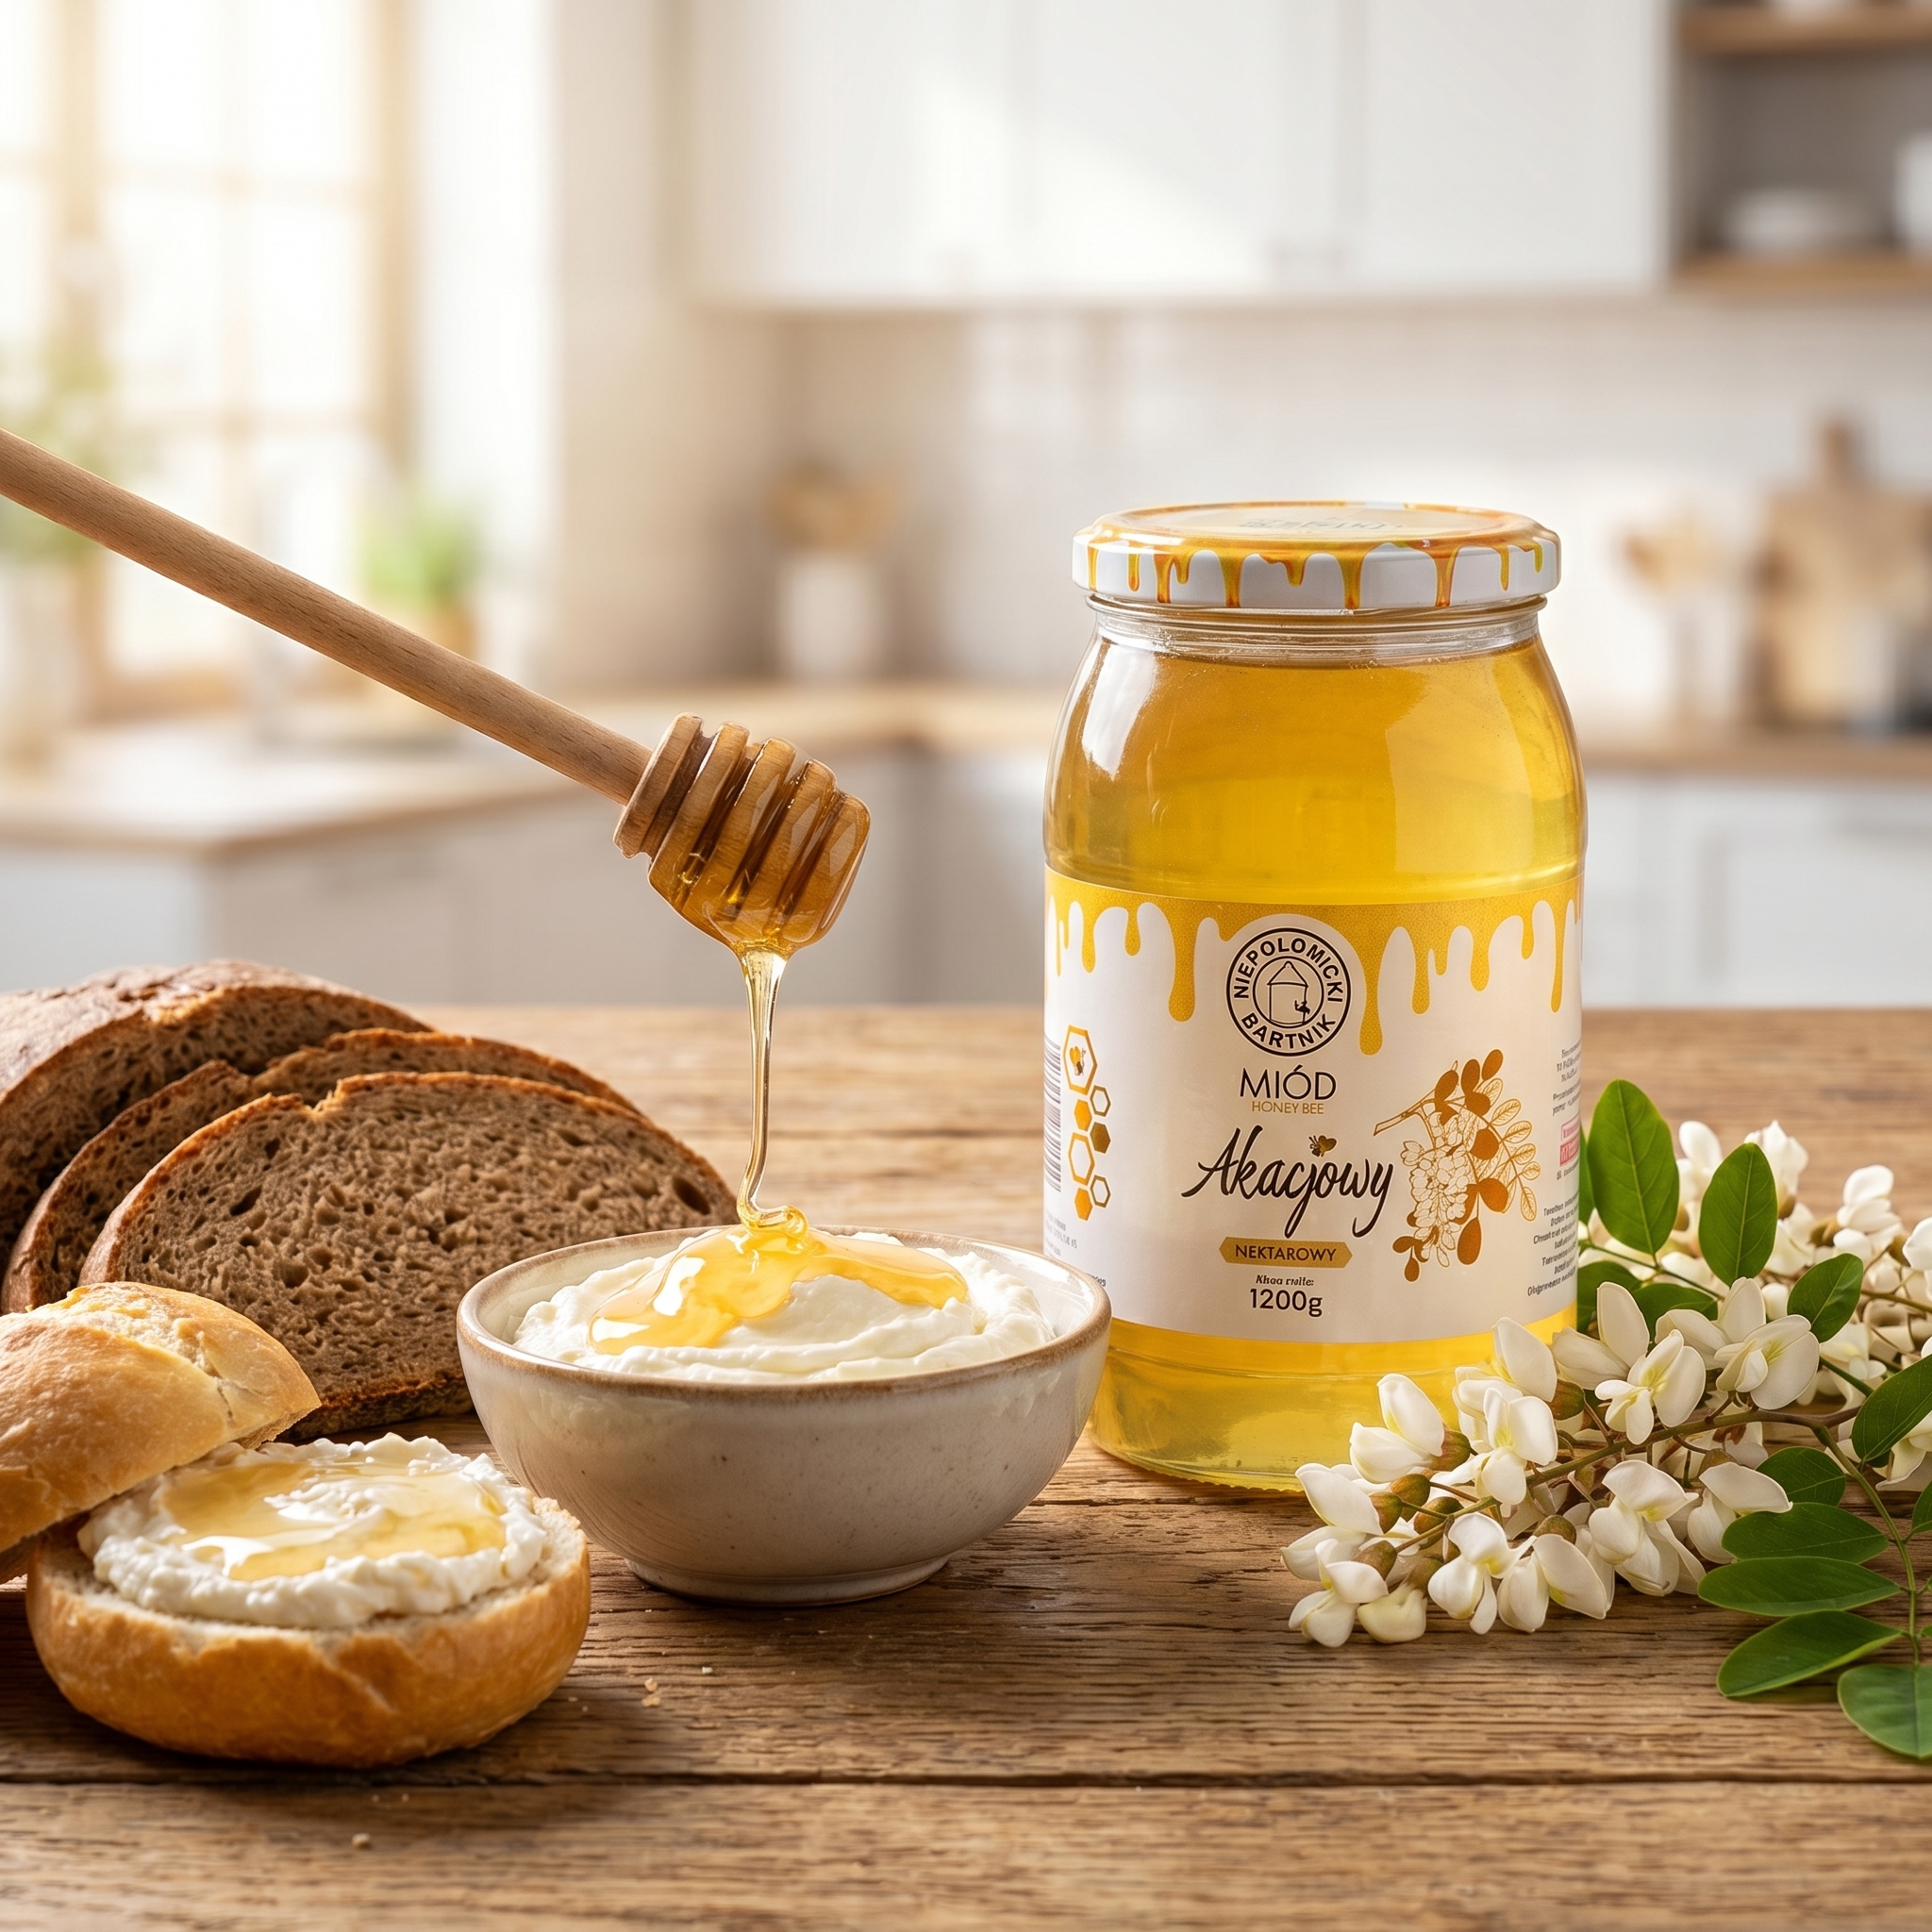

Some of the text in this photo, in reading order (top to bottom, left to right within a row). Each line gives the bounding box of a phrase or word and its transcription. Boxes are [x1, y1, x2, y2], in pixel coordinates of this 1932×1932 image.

[1233, 937, 1343, 1003] NIEPOLOMICKI
[1241, 1013, 1337, 1049] BARTNIK
[1239, 1064, 1338, 1101] MIÓD
[1251, 1100, 1324, 1114] HONEY BEE
[1180, 1124, 1394, 1240] Akacjowy
[1235, 1243, 1338, 1262] NEKTAROWY
[1250, 1288, 1324, 1318] 1200g
